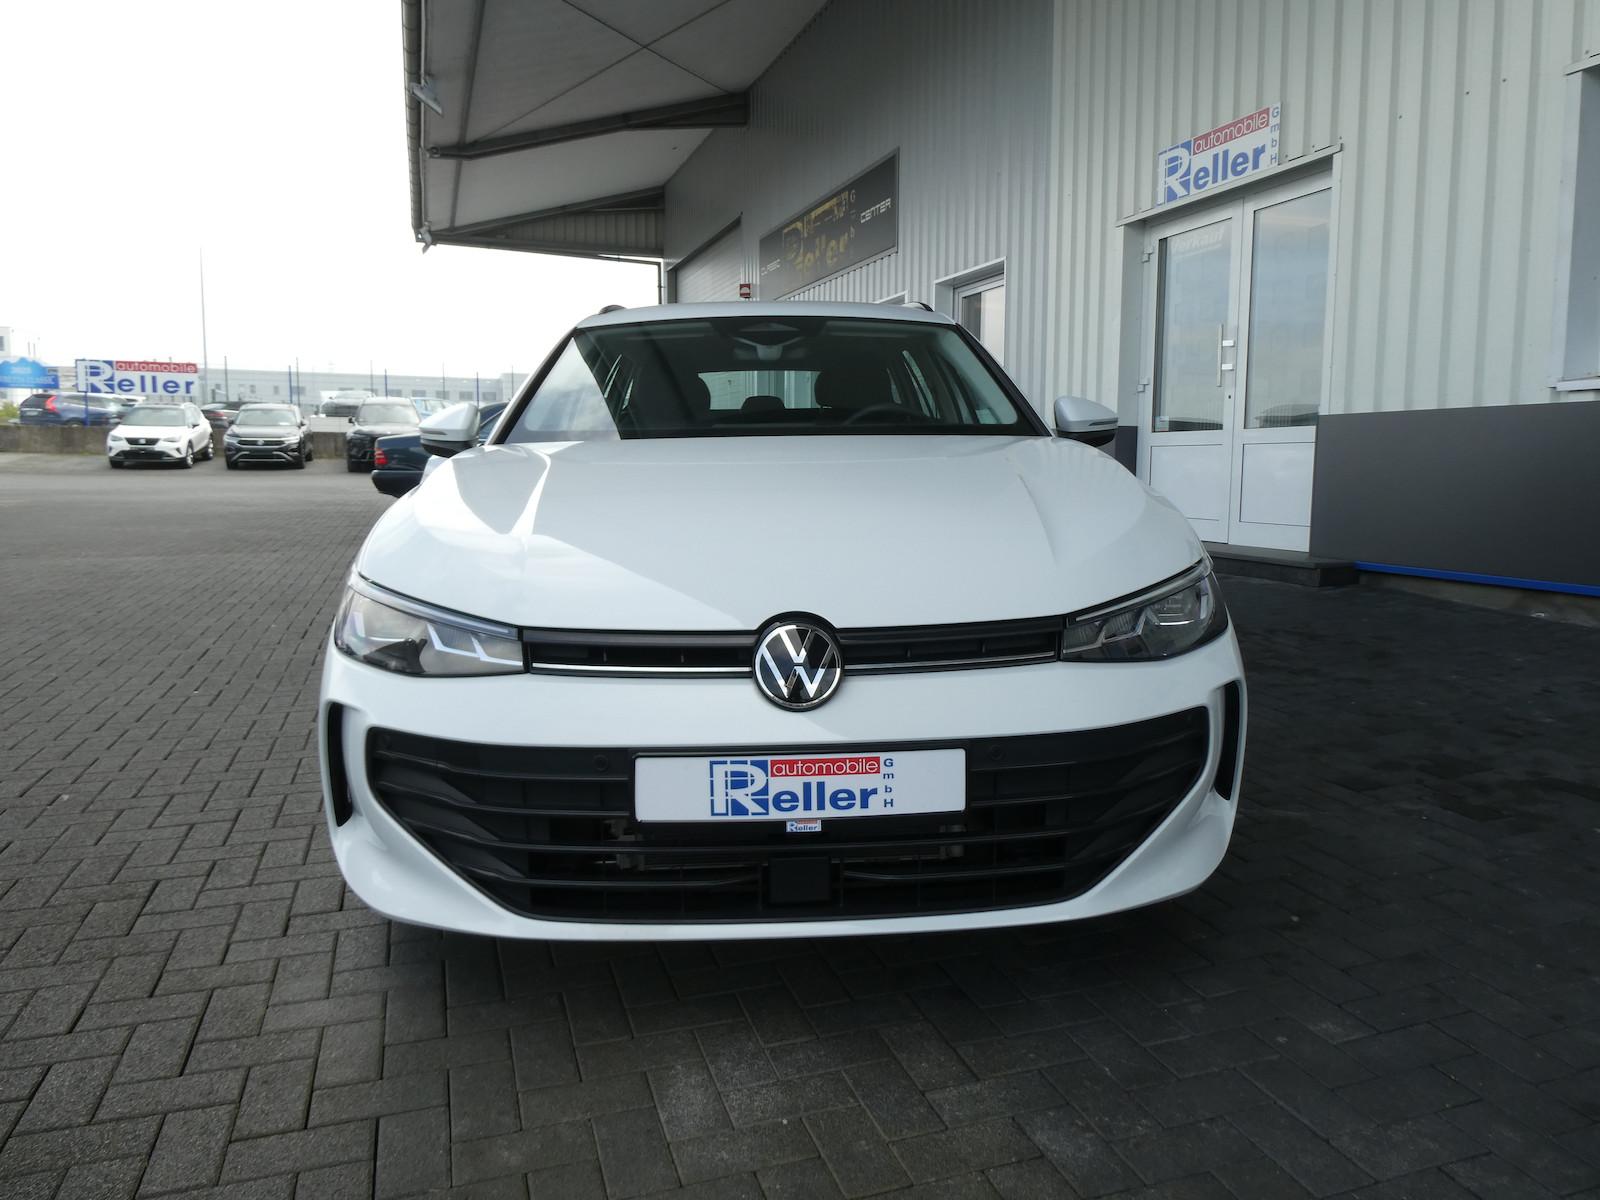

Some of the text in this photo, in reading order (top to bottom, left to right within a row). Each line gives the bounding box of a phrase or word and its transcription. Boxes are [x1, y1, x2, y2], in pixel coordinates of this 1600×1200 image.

[1194, 112, 1268, 154] automobile
[1158, 140, 1266, 206] Reller
[76, 360, 194, 393] Reller
[116, 362, 196, 373] automobile
[710, 759, 878, 816] Reller
[772, 758, 879, 776] automobile
[883, 757, 894, 808] GmbH
